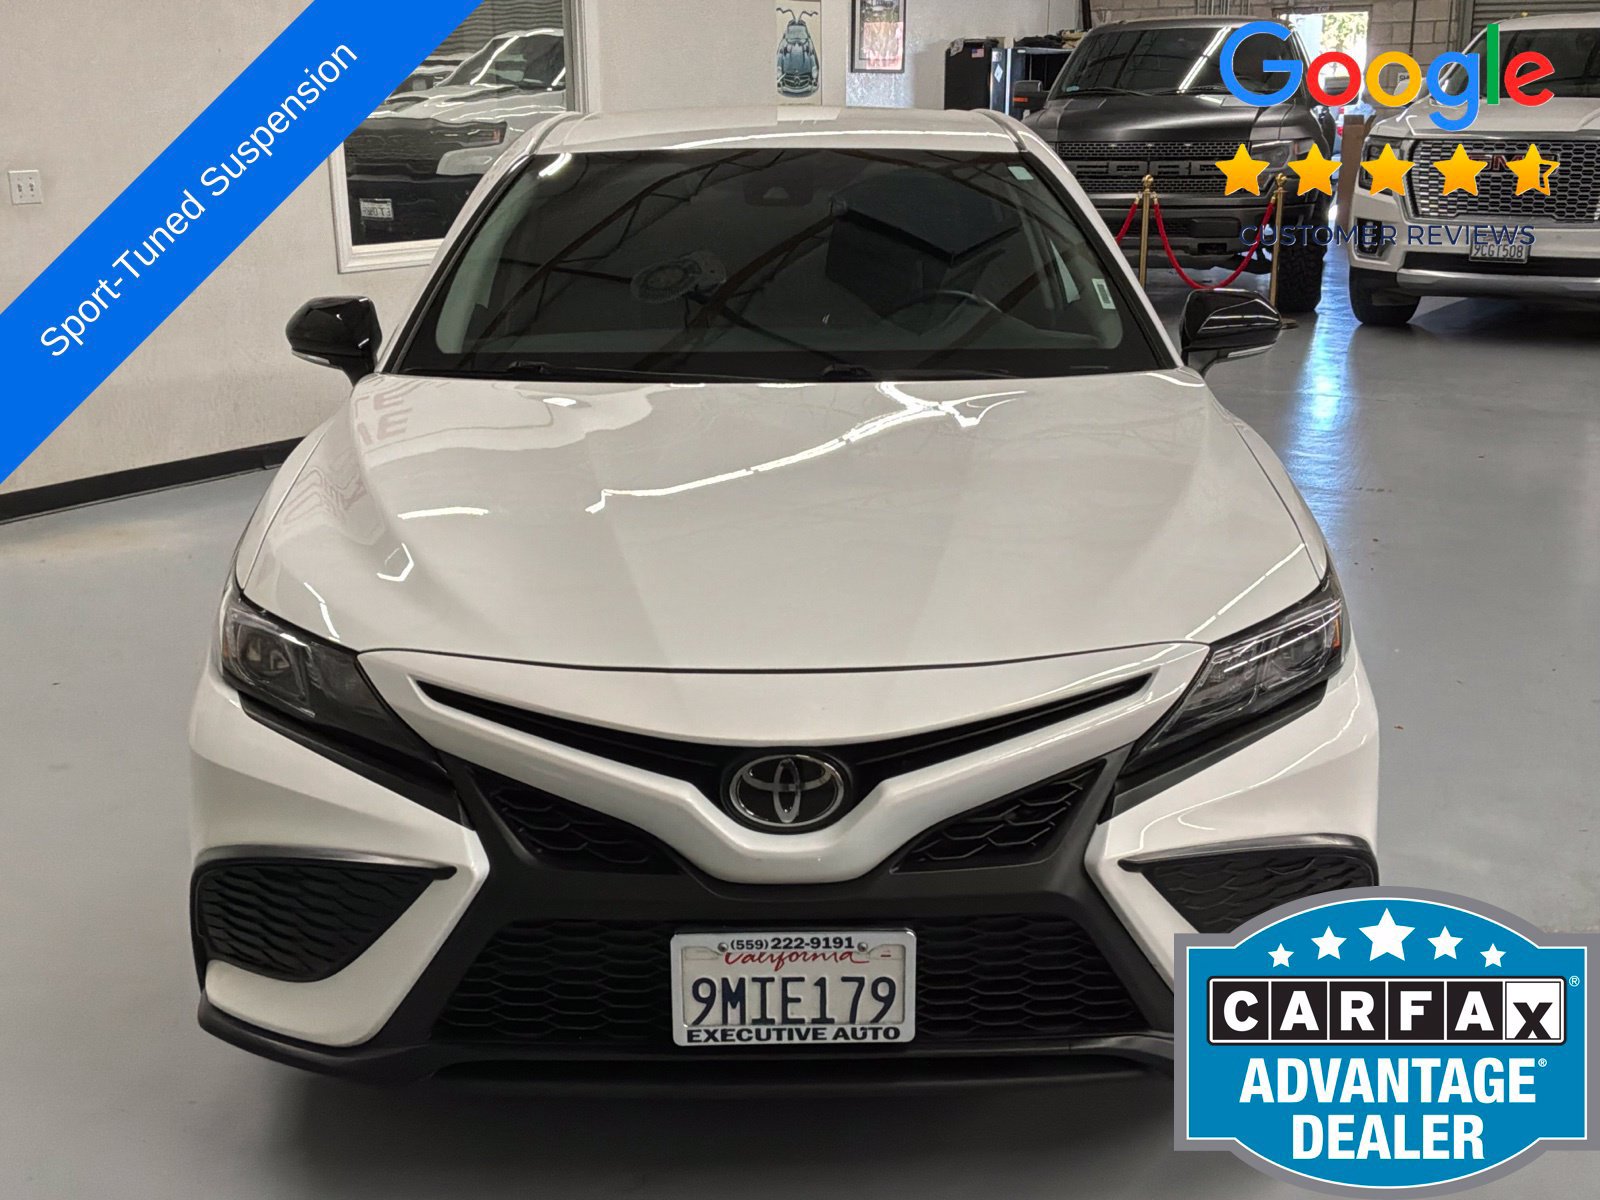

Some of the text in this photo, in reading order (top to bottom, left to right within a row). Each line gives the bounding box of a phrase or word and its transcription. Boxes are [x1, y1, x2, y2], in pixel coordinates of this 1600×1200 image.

[731, 936, 854, 951] (559) 222-9191
[691, 976, 897, 1025] 9MIE179
[687, 1026, 901, 1043] EXECUTIVE AUTO
